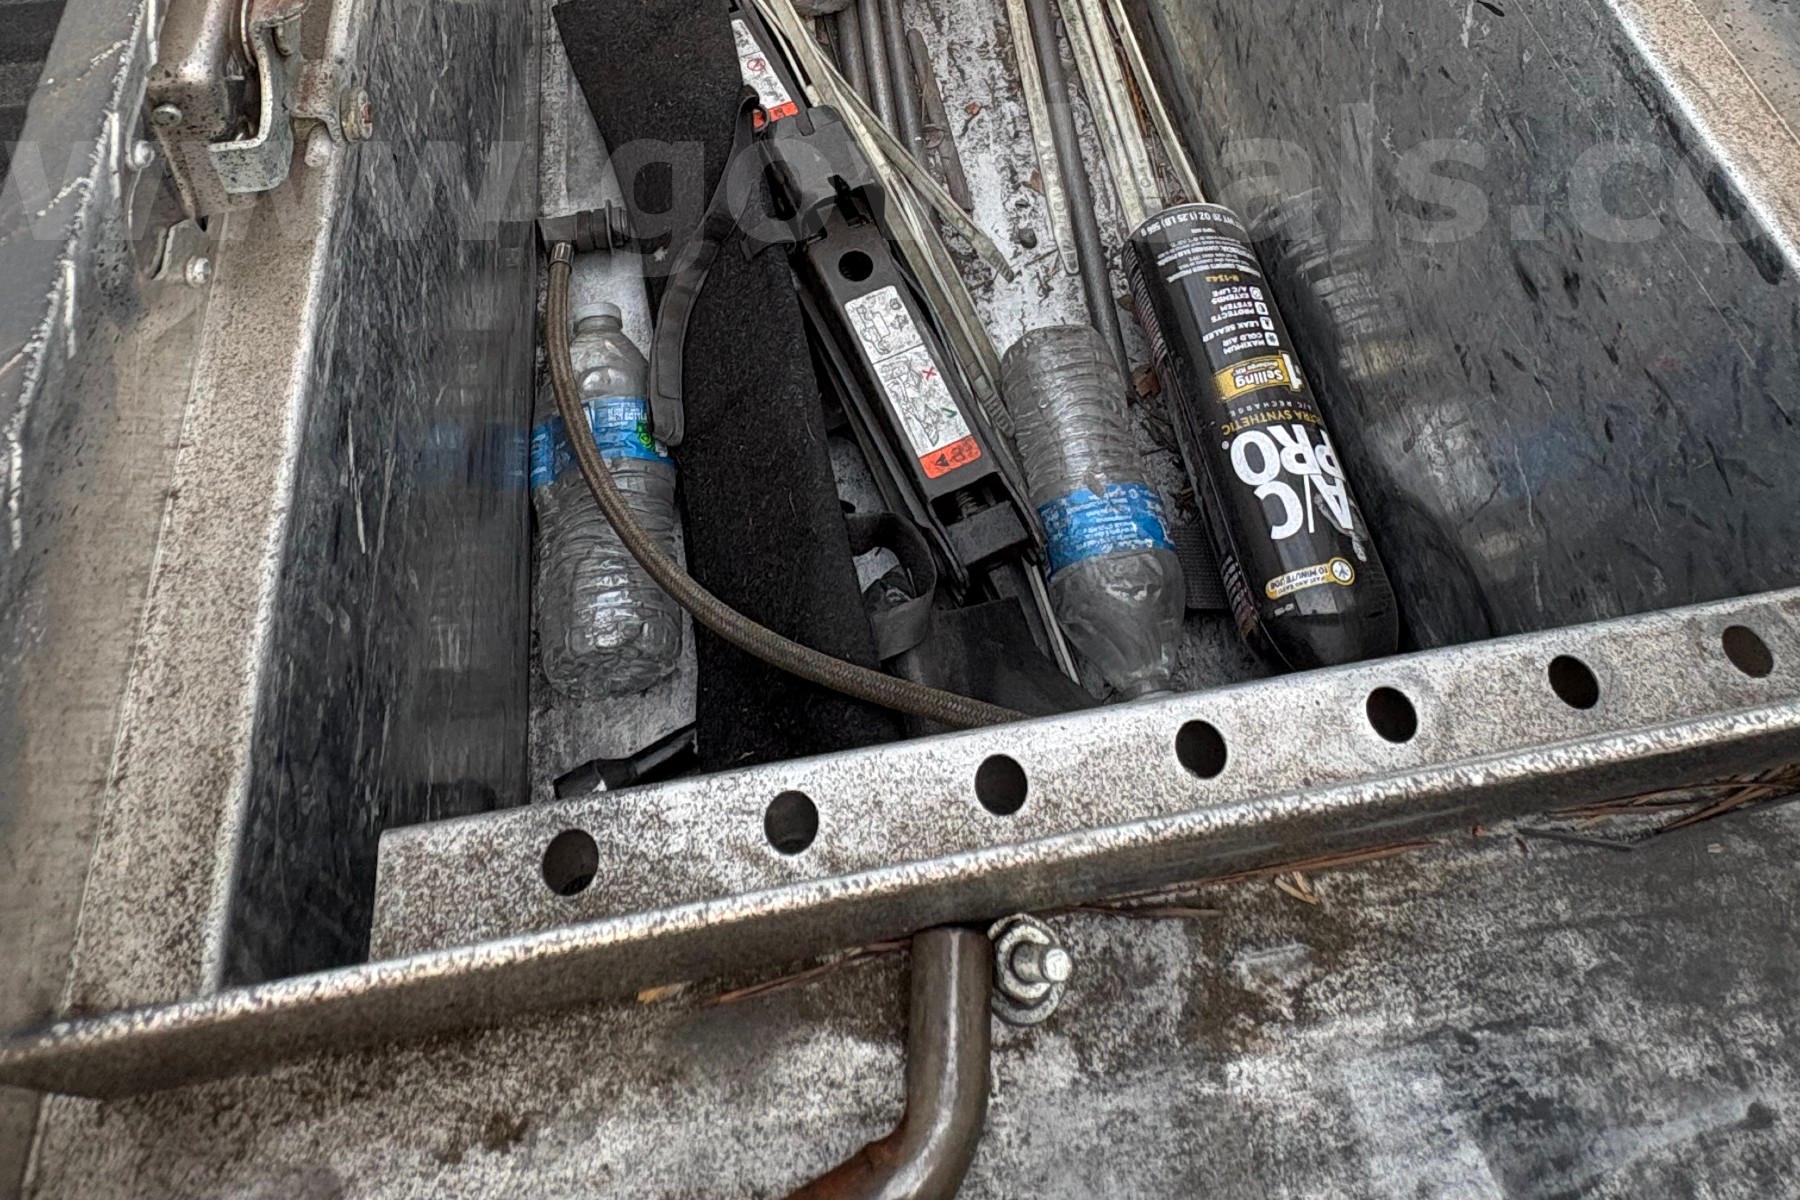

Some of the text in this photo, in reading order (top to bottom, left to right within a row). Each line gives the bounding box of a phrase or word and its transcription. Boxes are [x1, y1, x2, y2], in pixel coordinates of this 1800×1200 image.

[1211, 293, 1250, 304] EXTENDS
[1220, 301, 1253, 312] SYSTEM
[1210, 308, 1255, 323] PROTECTS
[1202, 320, 1260, 342] LEAK SEALER
[1222, 332, 1263, 347] COLD AIR
[1222, 340, 1265, 355] MAXIMUM
[1235, 369, 1284, 388] Selling
[1229, 400, 1292, 417] RECHARGE
[1221, 410, 1292, 435] SYNTHETIC
[1230, 424, 1346, 486] PRO
[1253, 474, 1354, 540] A/C
[1286, 569, 1317, 583] MINUTE
